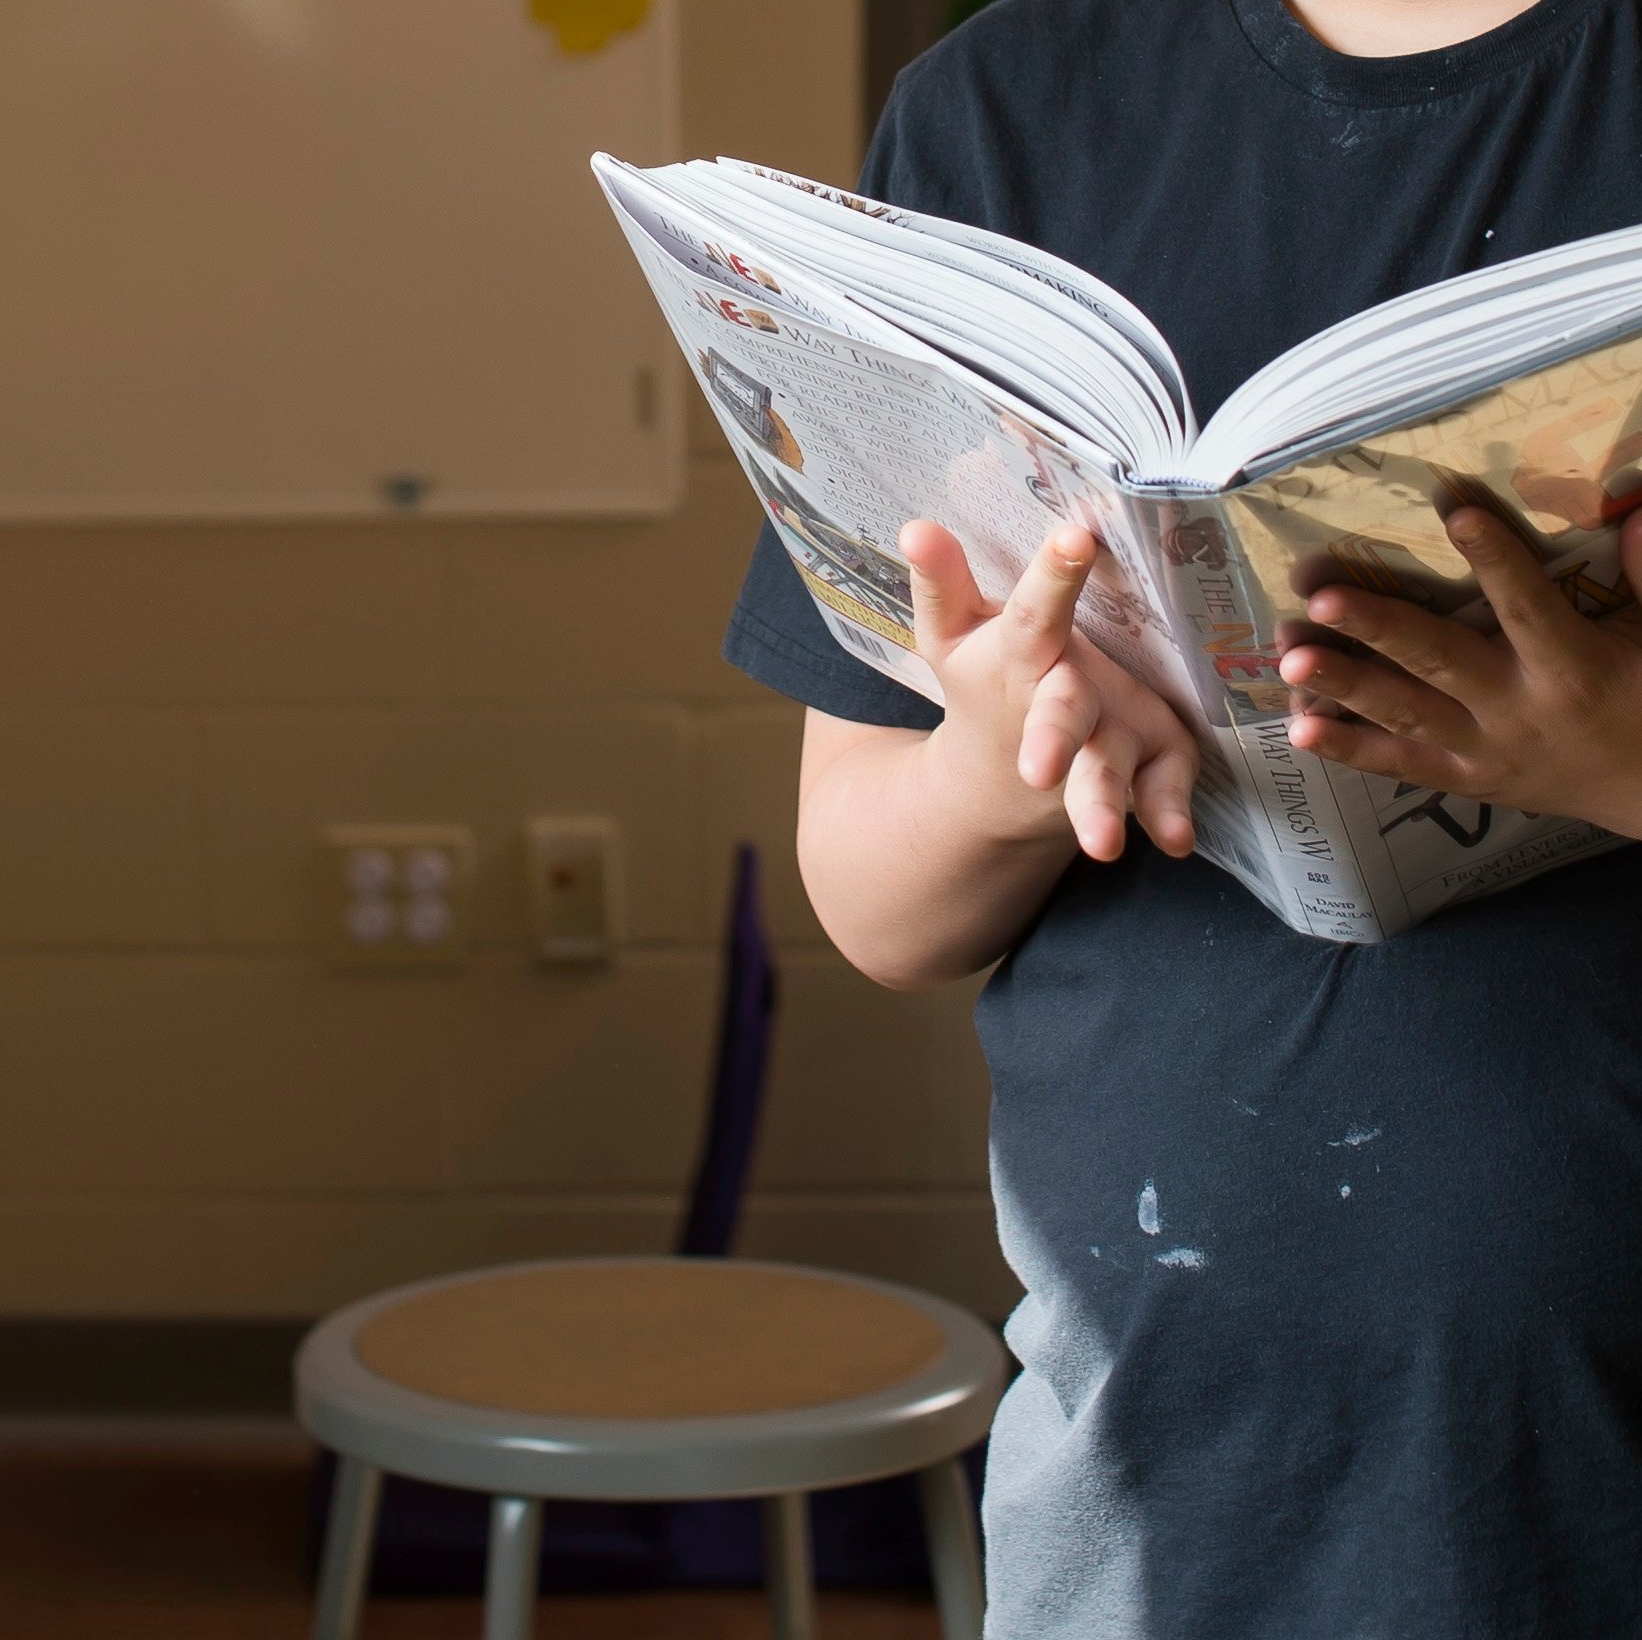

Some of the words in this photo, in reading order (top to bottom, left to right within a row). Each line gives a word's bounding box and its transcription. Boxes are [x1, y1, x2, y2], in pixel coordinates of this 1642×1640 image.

[783, 287, 835, 327] WAY
[711, 320, 877, 391] COMPREHENSIVE,
[781, 323, 842, 358] WAY
[841, 343, 938, 394] THINGS
[939, 384, 1010, 436] WORK
[713, 332, 848, 396] ENTERTAINING
[852, 388, 960, 438] REFERENCE
[755, 367, 793, 390] FOR
[797, 384, 883, 422] READERS
[885, 414, 915, 433] OF
[918, 426, 954, 449] ALL
[788, 408, 950, 475] AWARD-WINNING
[790, 393, 840, 421] THIS
[843, 414, 928, 453] CLASSIC,
[799, 438, 885, 479] UPDATED
[888, 471, 918, 490] TO
[809, 429, 859, 455] NOW
[863, 449, 913, 475] BEEN
[819, 483, 909, 527] MAMMOT
[1196, 573, 1238, 615] THE
[1254, 722, 1293, 766] WAY
[1270, 767, 1320, 835] THINGS
[1442, 860, 1501, 888] FROM
[1504, 827, 1580, 864] LEVERS
[1472, 876, 1486, 889] A
[1493, 850, 1559, 881] VISUAL
[1305, 903, 1374, 919] MACAULAY
[1316, 897, 1356, 909] DAVID
